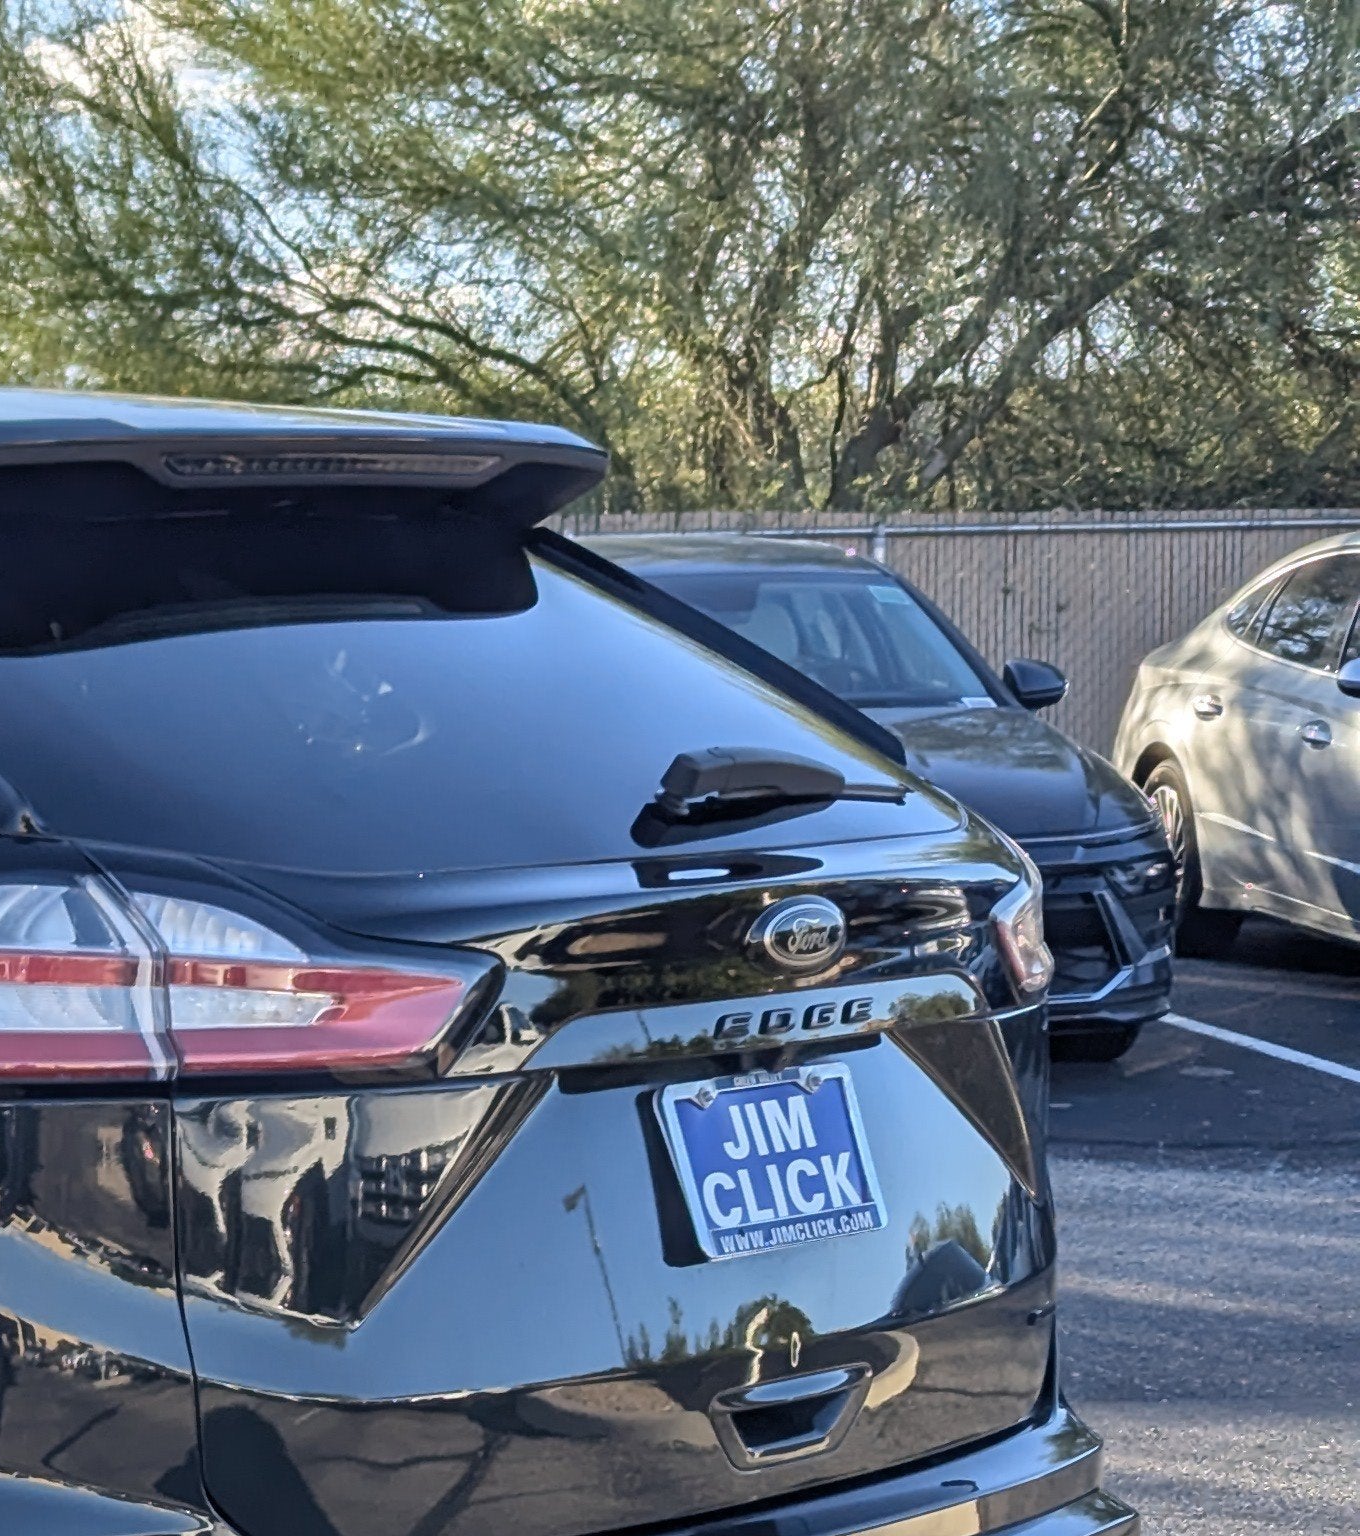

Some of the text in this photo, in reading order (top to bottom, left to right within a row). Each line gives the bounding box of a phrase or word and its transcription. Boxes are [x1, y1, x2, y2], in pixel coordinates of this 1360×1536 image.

[788, 917, 832, 955] Ford
[713, 996, 874, 1040] EDGE
[723, 1094, 818, 1160] JIM
[702, 1151, 862, 1229] CLICK
[719, 1210, 875, 1254] WWW.JIMCLICK.COM
